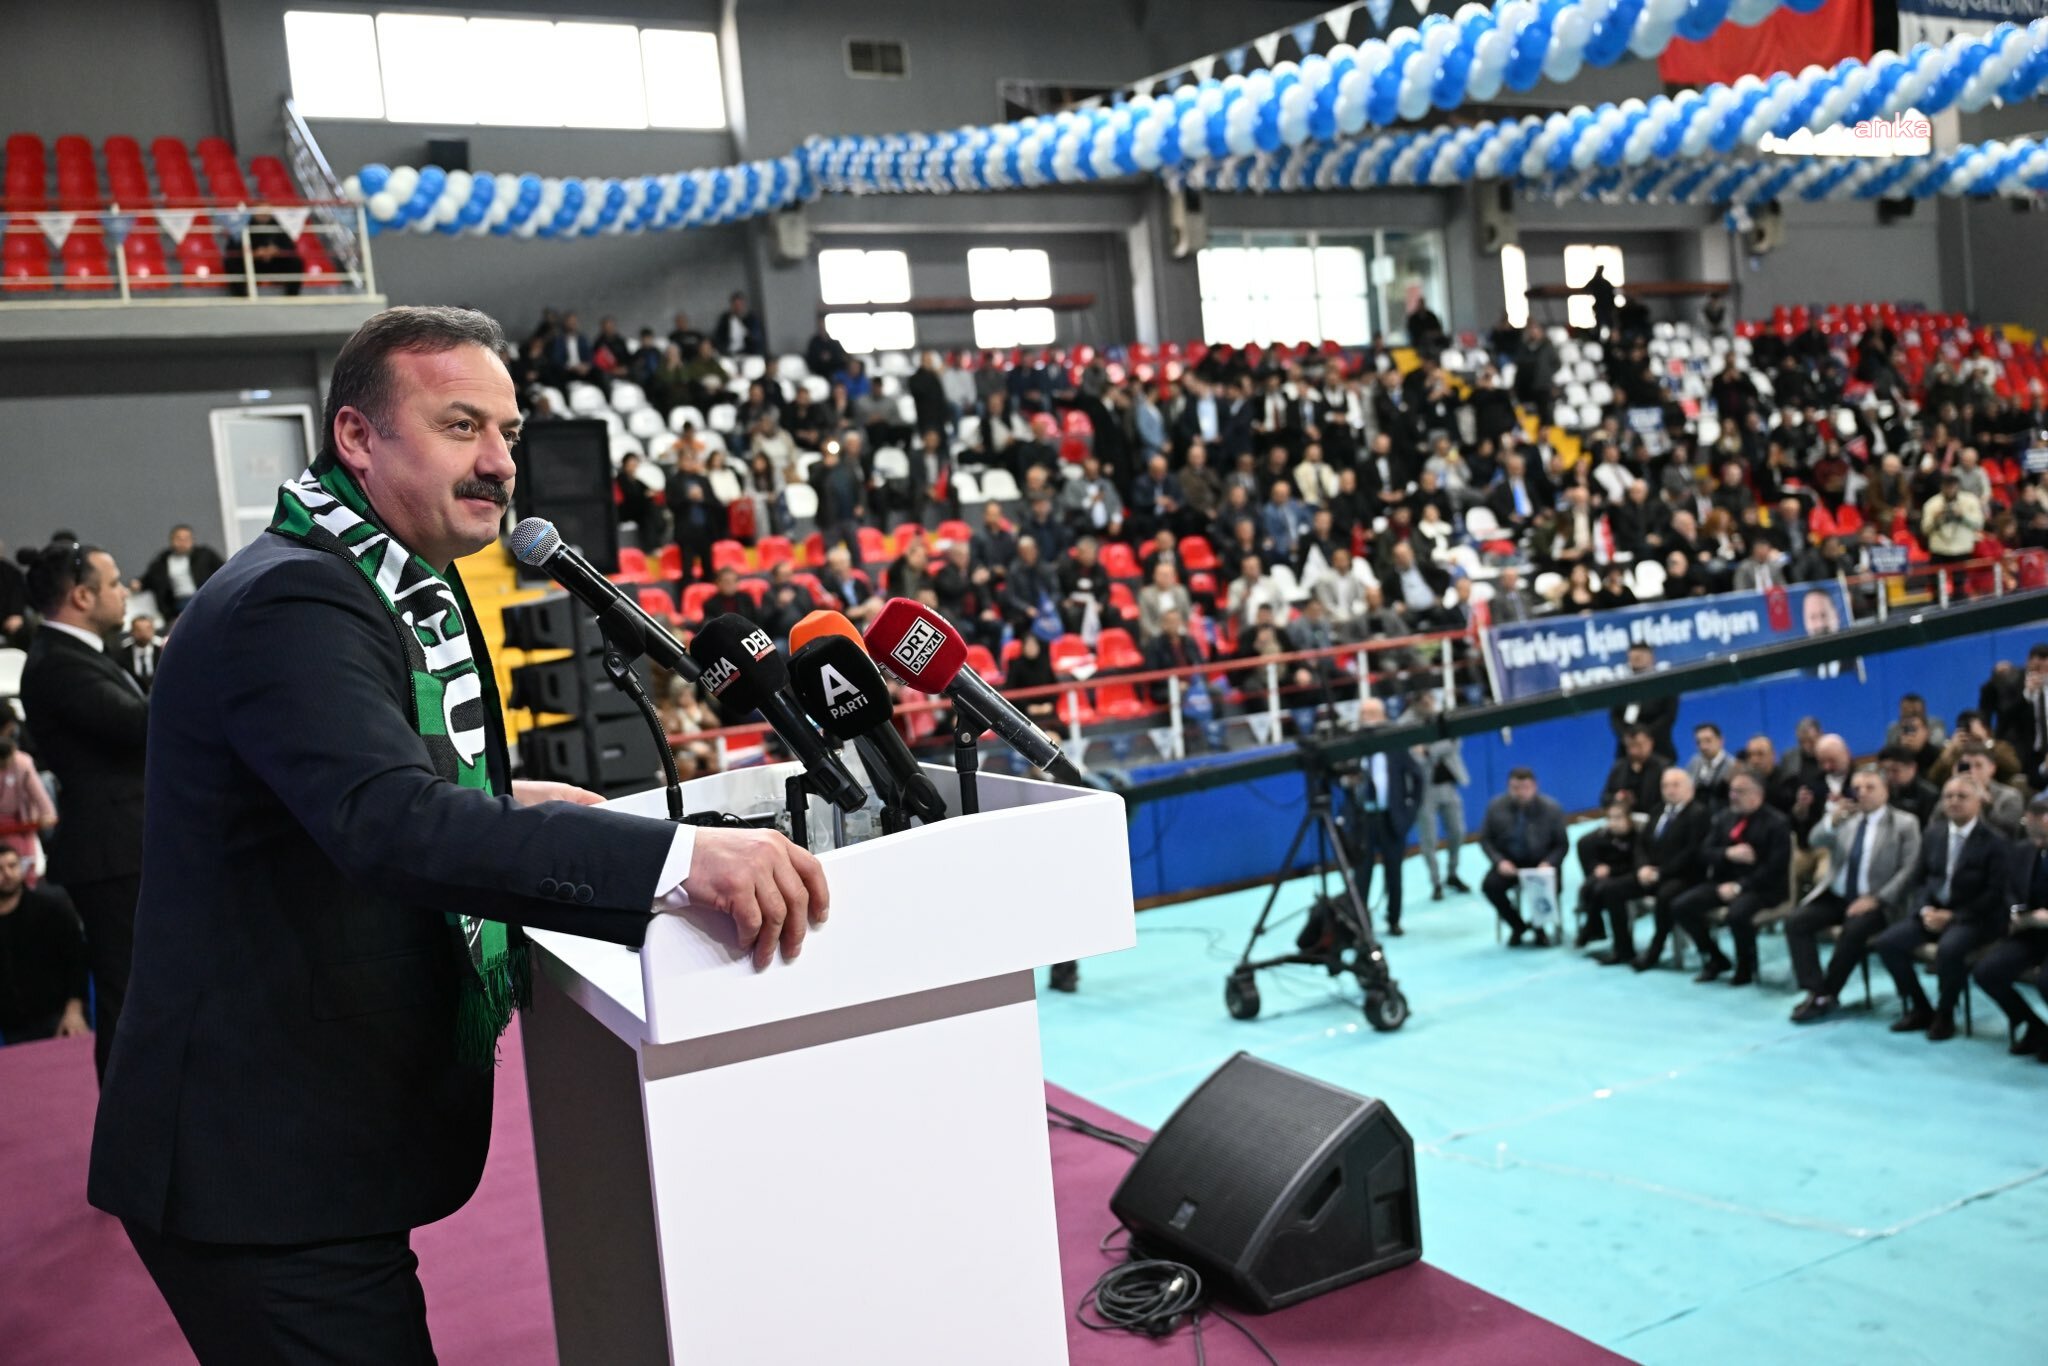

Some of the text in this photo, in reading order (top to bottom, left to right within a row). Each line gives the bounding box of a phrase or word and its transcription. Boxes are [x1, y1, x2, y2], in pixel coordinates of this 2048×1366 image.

[740, 627, 773, 657] DEH
[899, 624, 929, 662] DRT
[1498, 631, 1584, 668] Türkiye
[699, 656, 739, 693] DEHA
[820, 663, 860, 707] A
